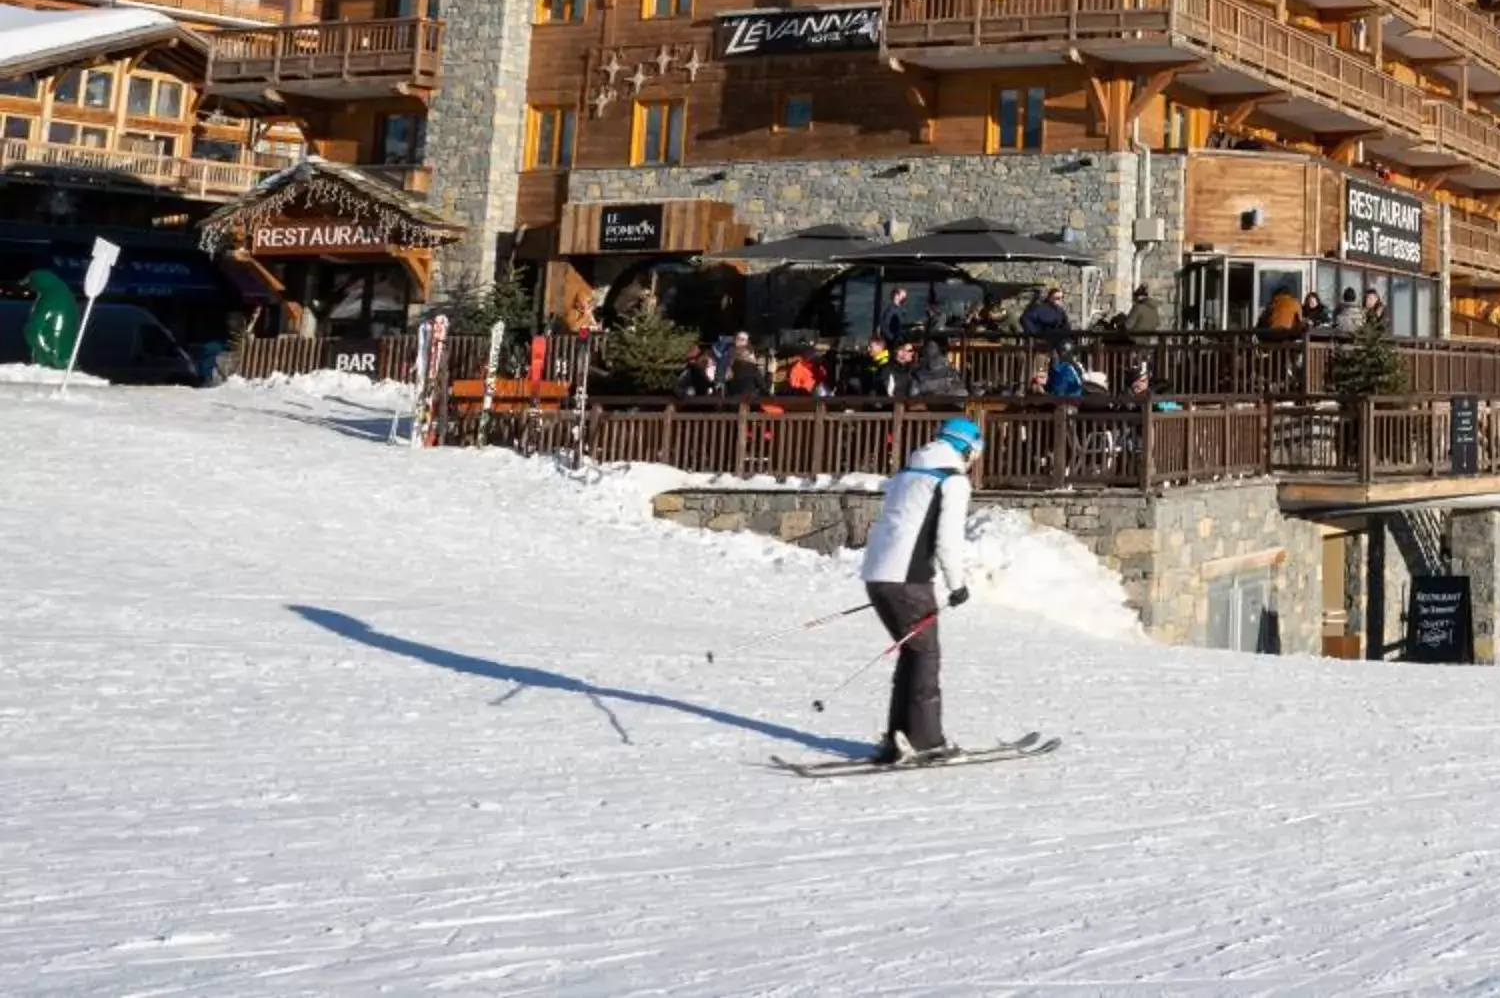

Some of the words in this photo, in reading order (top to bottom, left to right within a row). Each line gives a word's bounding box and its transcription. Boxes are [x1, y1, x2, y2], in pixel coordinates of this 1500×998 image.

[1349, 189, 1421, 232] RESTAURANT
[257, 225, 389, 247] RESTAURAN
[1348, 221, 1371, 253] Les
[1371, 225, 1421, 263] Terrasses
[336, 353, 377, 371] BAR
